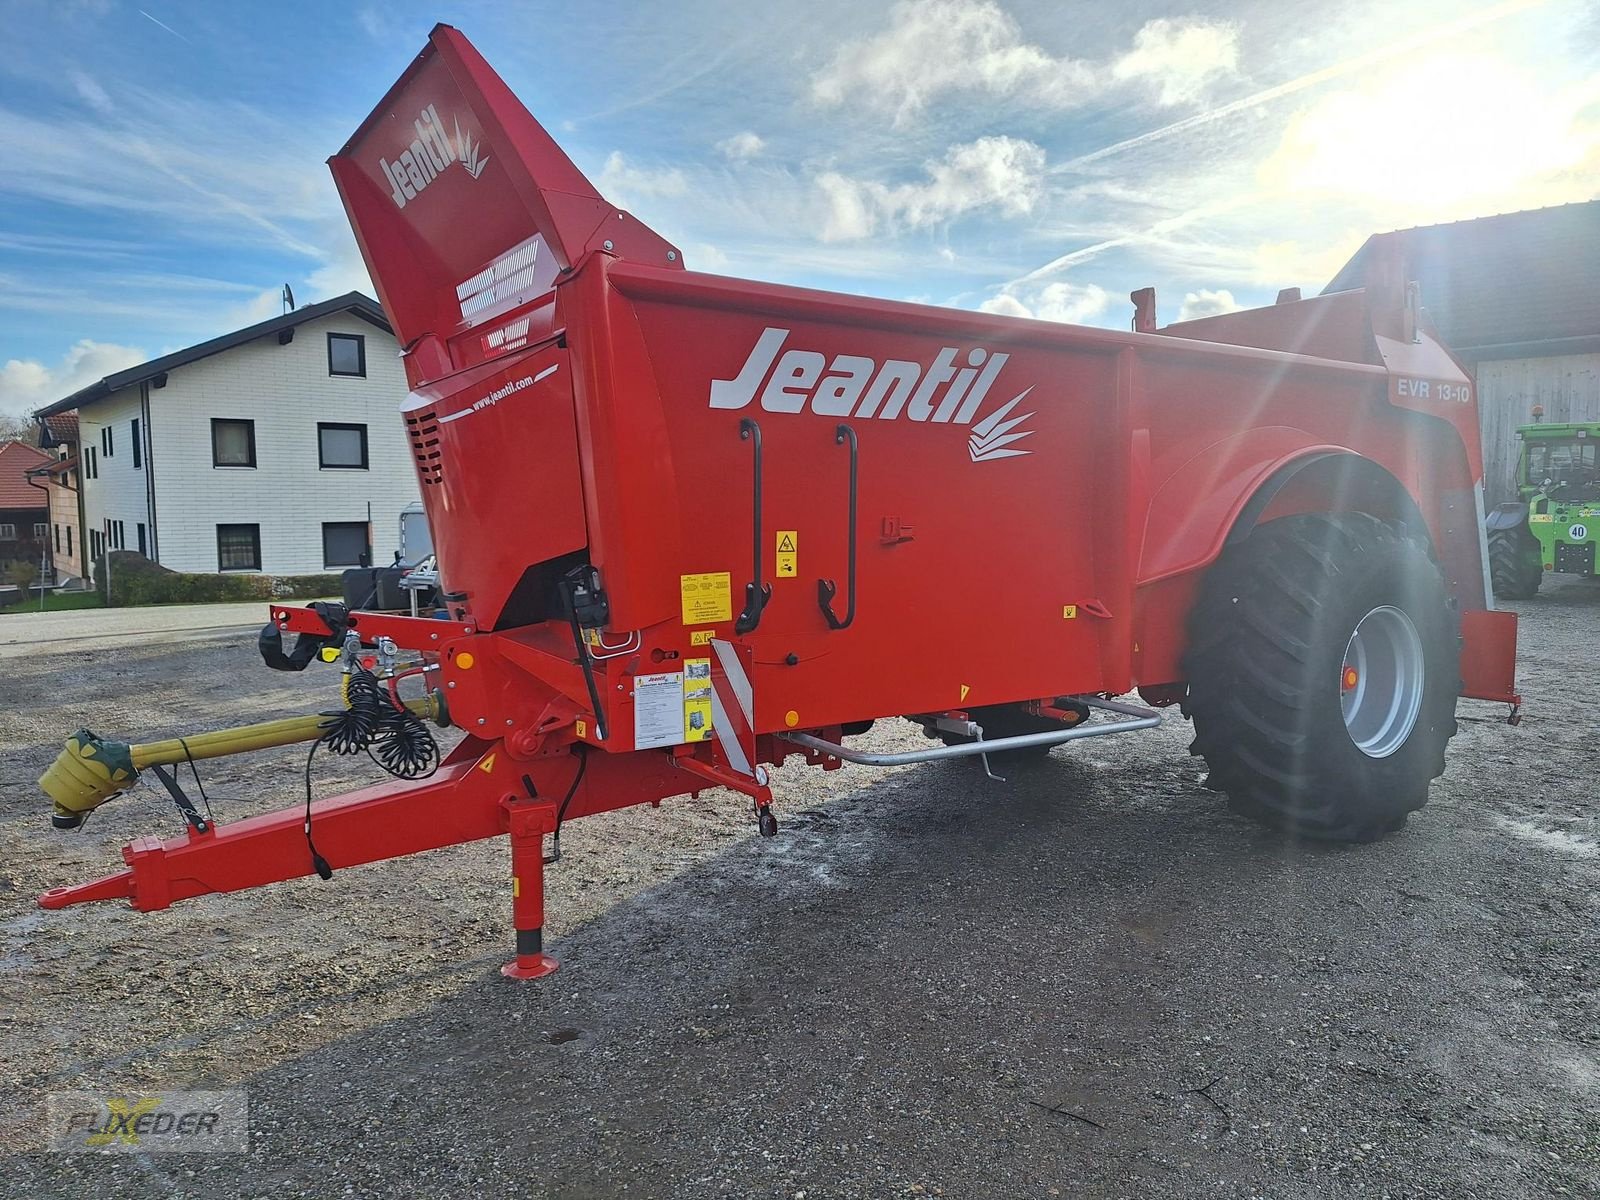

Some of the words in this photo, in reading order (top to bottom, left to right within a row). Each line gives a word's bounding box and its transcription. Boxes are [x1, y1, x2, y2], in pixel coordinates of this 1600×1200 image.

[380, 103, 457, 209] Jeantil
[472, 375, 534, 410] www.jeantil.com
[709, 327, 1010, 424] Jeantil
[1397, 378, 1430, 398] EVR
[1436, 383, 1470, 403] 13-10
[1572, 526, 1585, 538] 40
